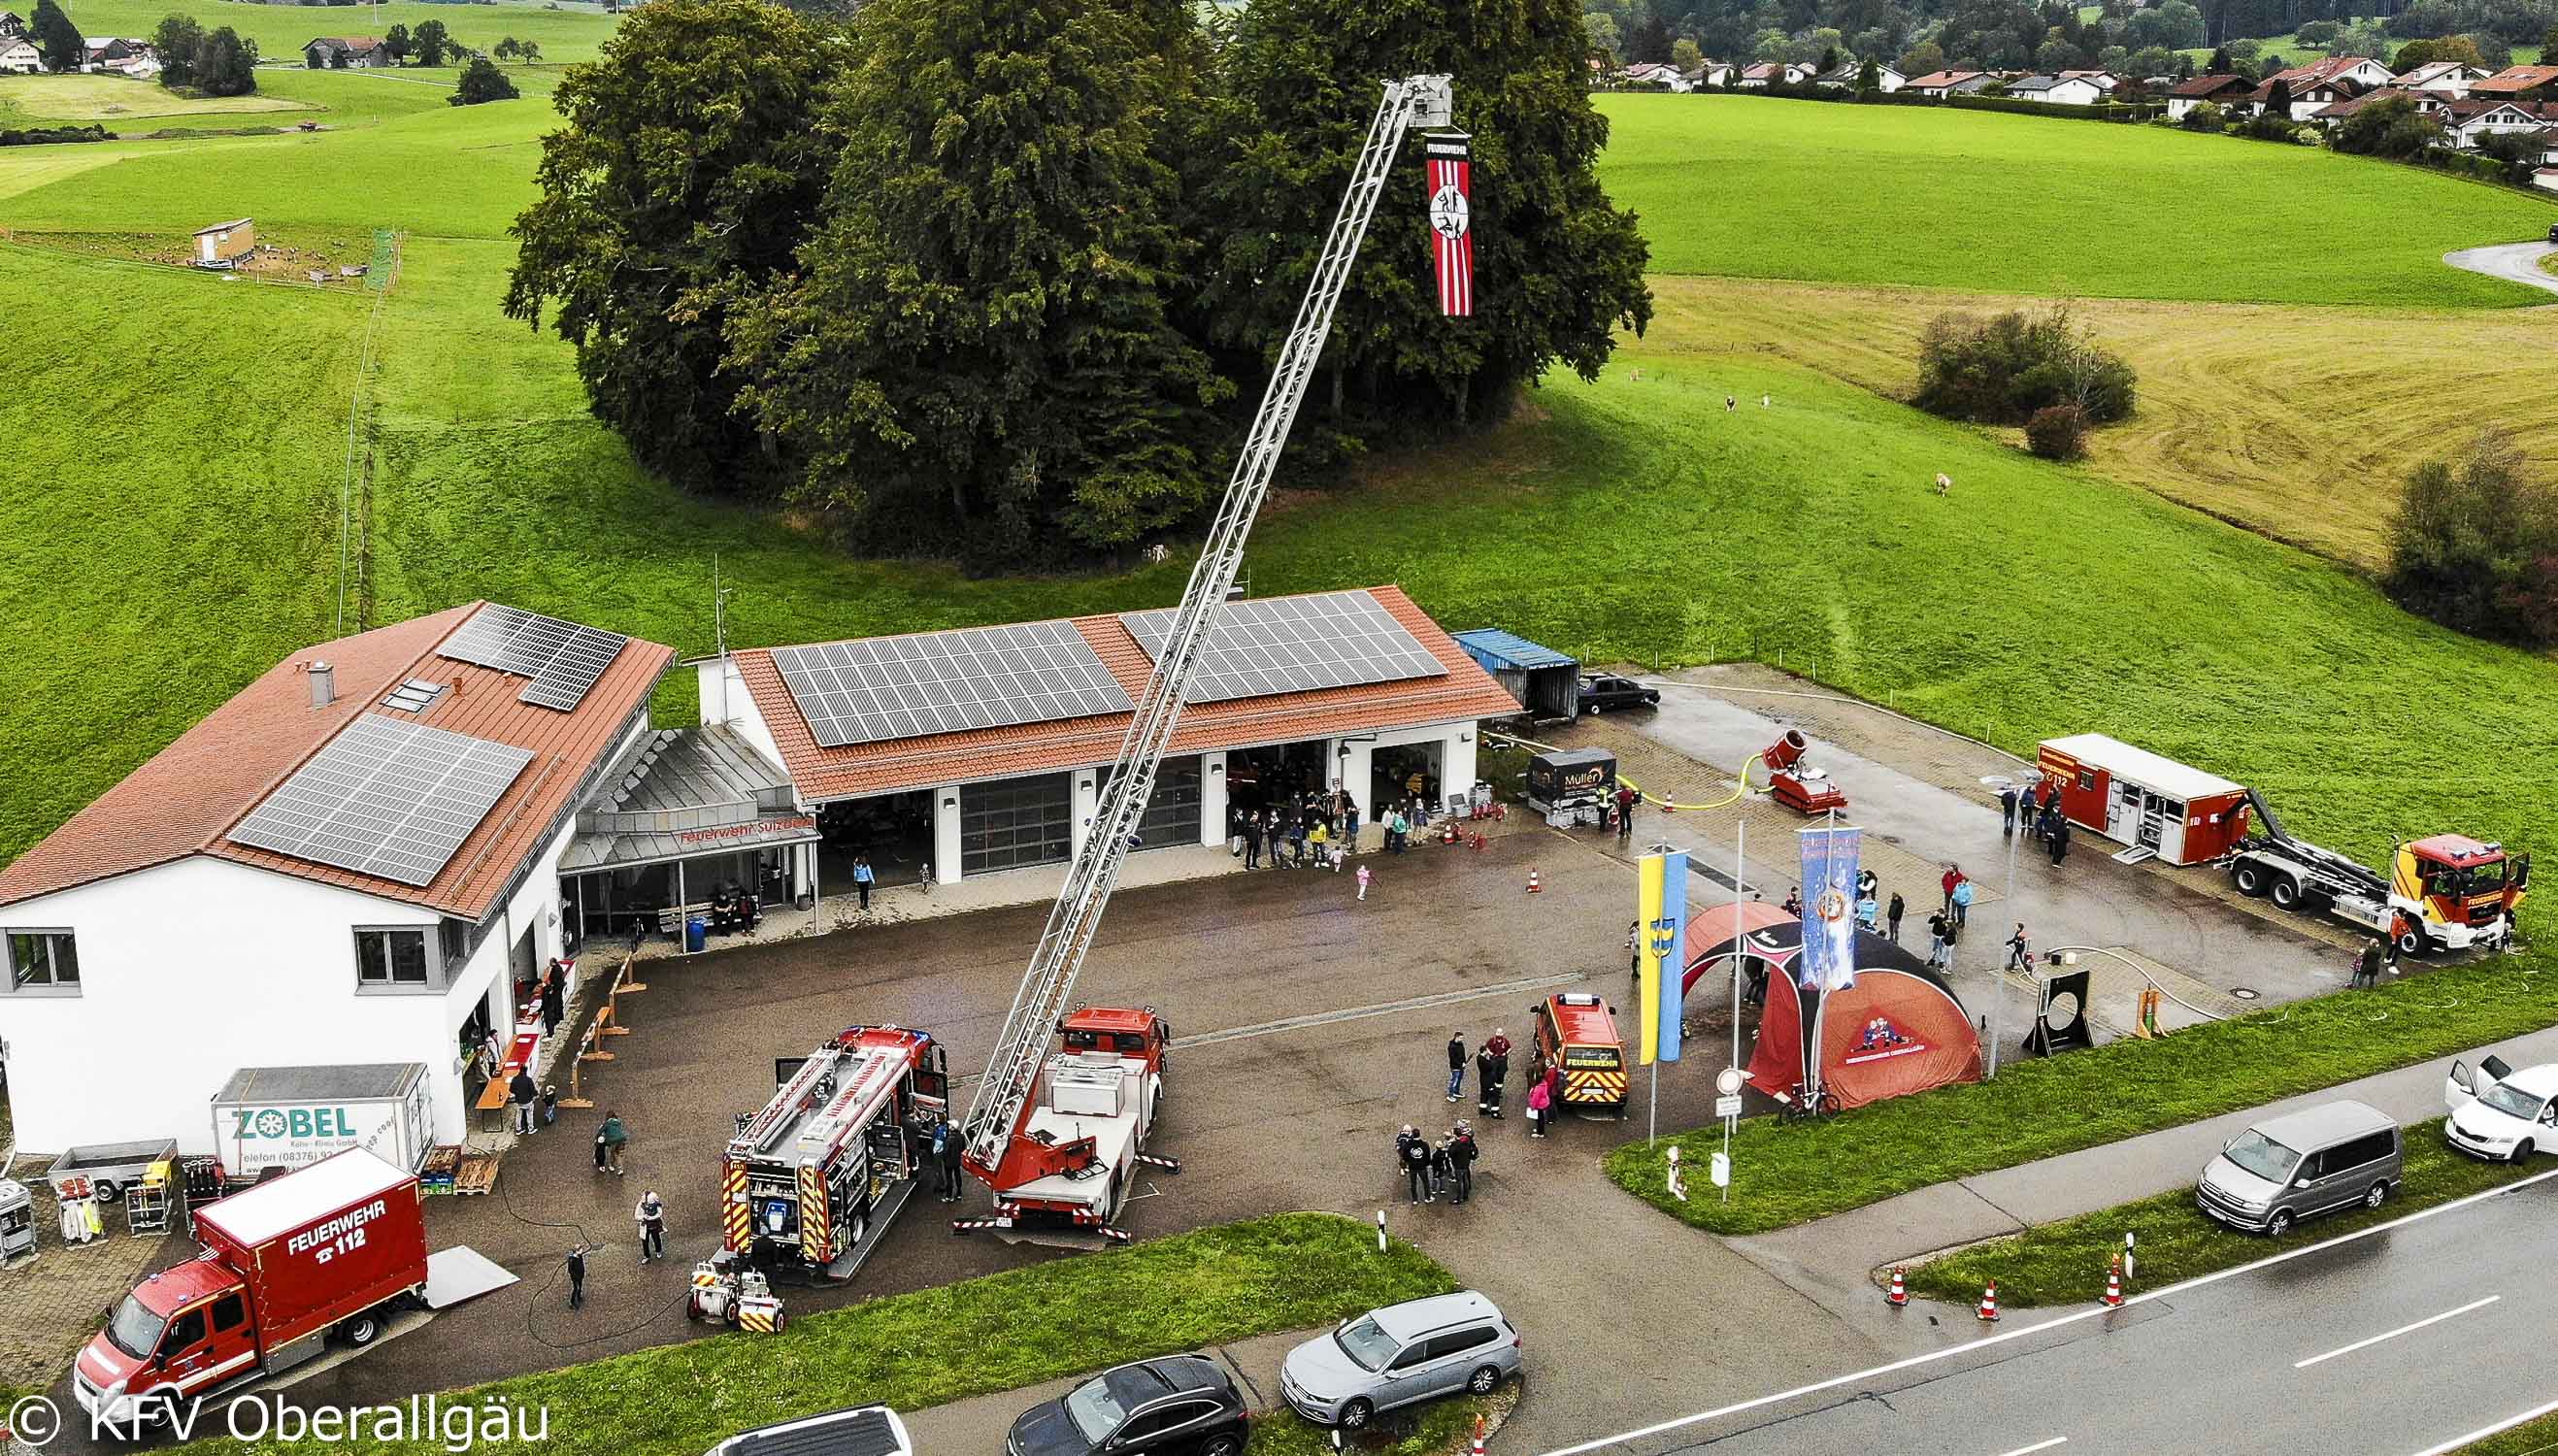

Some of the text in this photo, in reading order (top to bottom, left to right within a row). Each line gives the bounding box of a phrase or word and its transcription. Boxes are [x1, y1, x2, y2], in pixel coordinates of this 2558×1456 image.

[1427, 143, 1467, 155] FEUERWEHR
[2039, 760, 2076, 780] FEUERWEHR
[2052, 774, 2068, 787] 112
[681, 824, 755, 844] Feuerwehr
[1566, 1058, 1618, 1068] FEUERWEHR
[232, 1108, 357, 1140] ZOBEL
[243, 1151, 276, 1163] elefon
[288, 1200, 386, 1256] FEUERWEHR
[335, 1228, 366, 1255] 112
